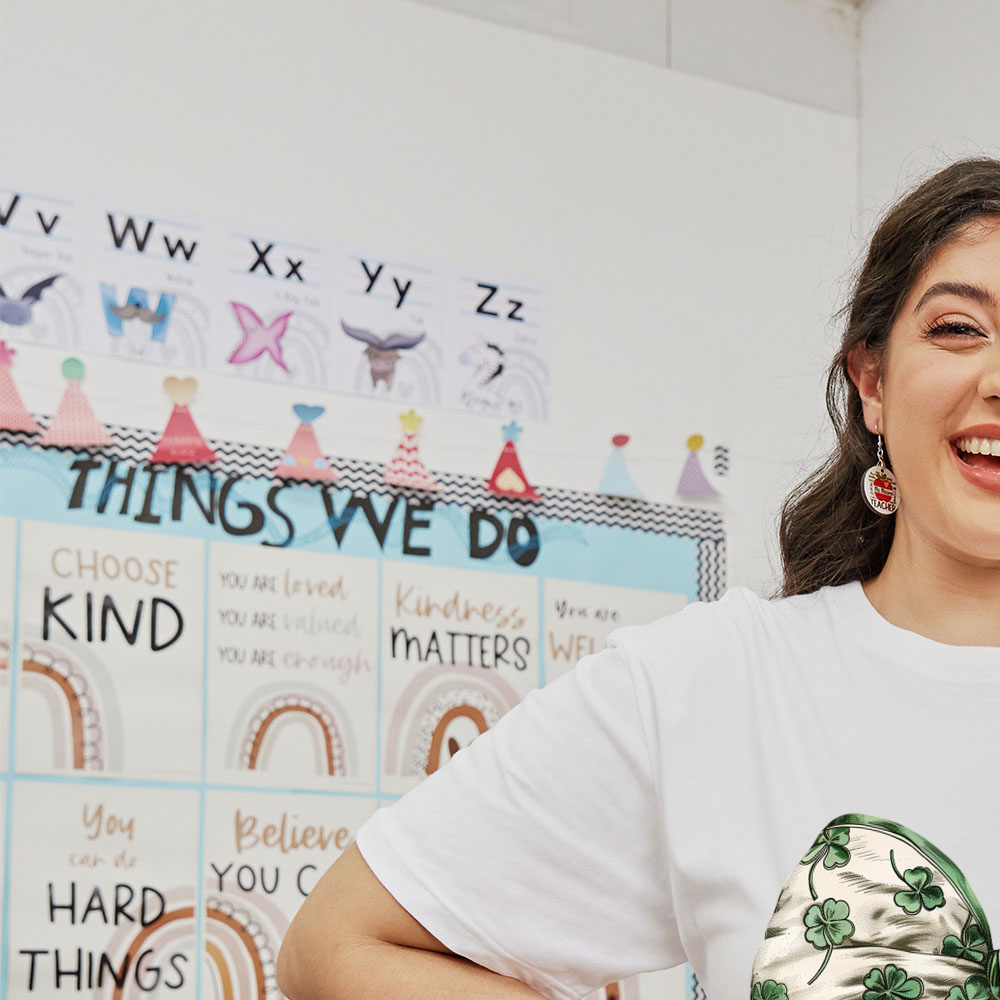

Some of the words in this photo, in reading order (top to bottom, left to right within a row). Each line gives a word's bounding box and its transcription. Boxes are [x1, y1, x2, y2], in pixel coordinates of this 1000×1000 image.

[107, 214, 154, 252] W
[249, 240, 274, 276] X
[361, 261, 384, 293] Y
[476, 282, 499, 316] Z
[68, 458, 295, 548] THINGS
[321, 484, 436, 557] WE
[469, 508, 541, 567] DO
[51, 548, 180, 589] CHOOSE
[219, 570, 247, 592] YOU
[252, 574, 276, 592] ARE
[283, 571, 348, 601] loved
[43, 586, 184, 652] KIND
[218, 608, 247, 630] YOU
[252, 613, 276, 632] ARE
[394, 582, 528, 632] Kindness
[217, 647, 247, 669] YOU
[251, 650, 276, 669] ARE
[281, 652, 373, 687] enough
[82, 802, 135, 842] You
[234, 809, 350, 854] Believe
[211, 862, 280, 894] YOU
[48, 881, 167, 927] HARD
[19, 948, 189, 992] THINGS
